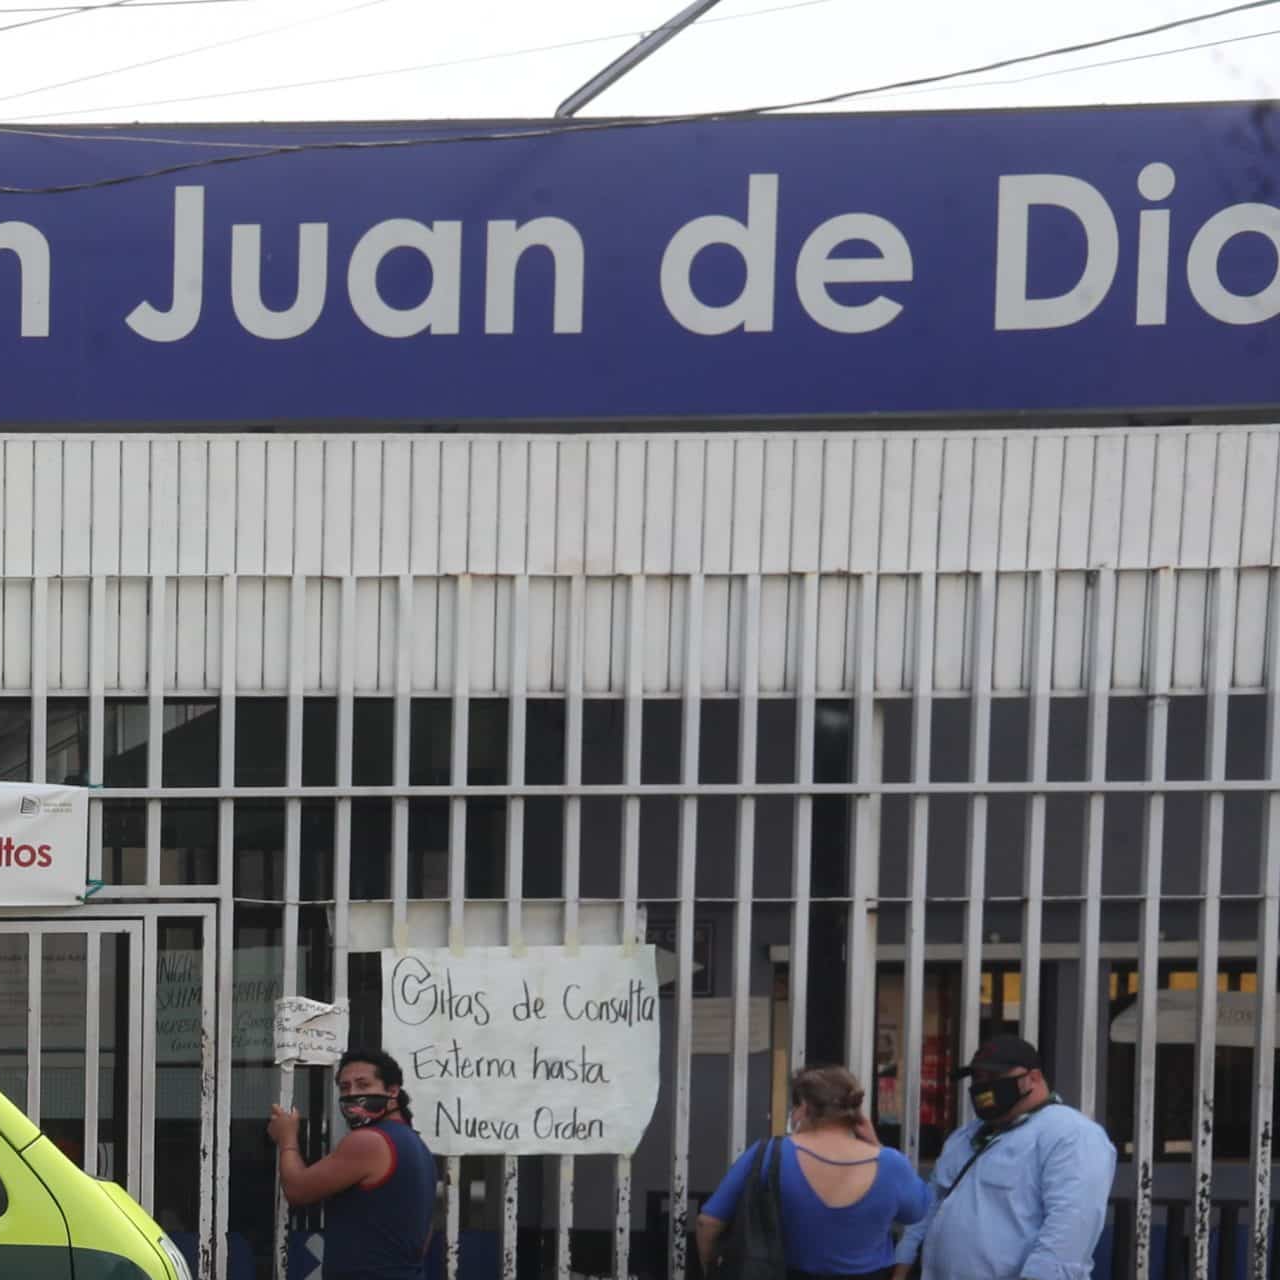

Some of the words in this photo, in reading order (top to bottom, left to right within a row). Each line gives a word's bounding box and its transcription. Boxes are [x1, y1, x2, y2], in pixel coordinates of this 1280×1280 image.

[124, 185, 585, 343] Juan
[659, 173, 914, 336] de
[993, 162, 1280, 331] Dio
[512, 979, 545, 1022] de
[562, 979, 655, 1027] Consulta
[409, 1039, 516, 1081] Externa
[532, 1044, 610, 1084] hasta
[435, 1097, 520, 1141] Nueva
[533, 1105, 604, 1141] Orden
